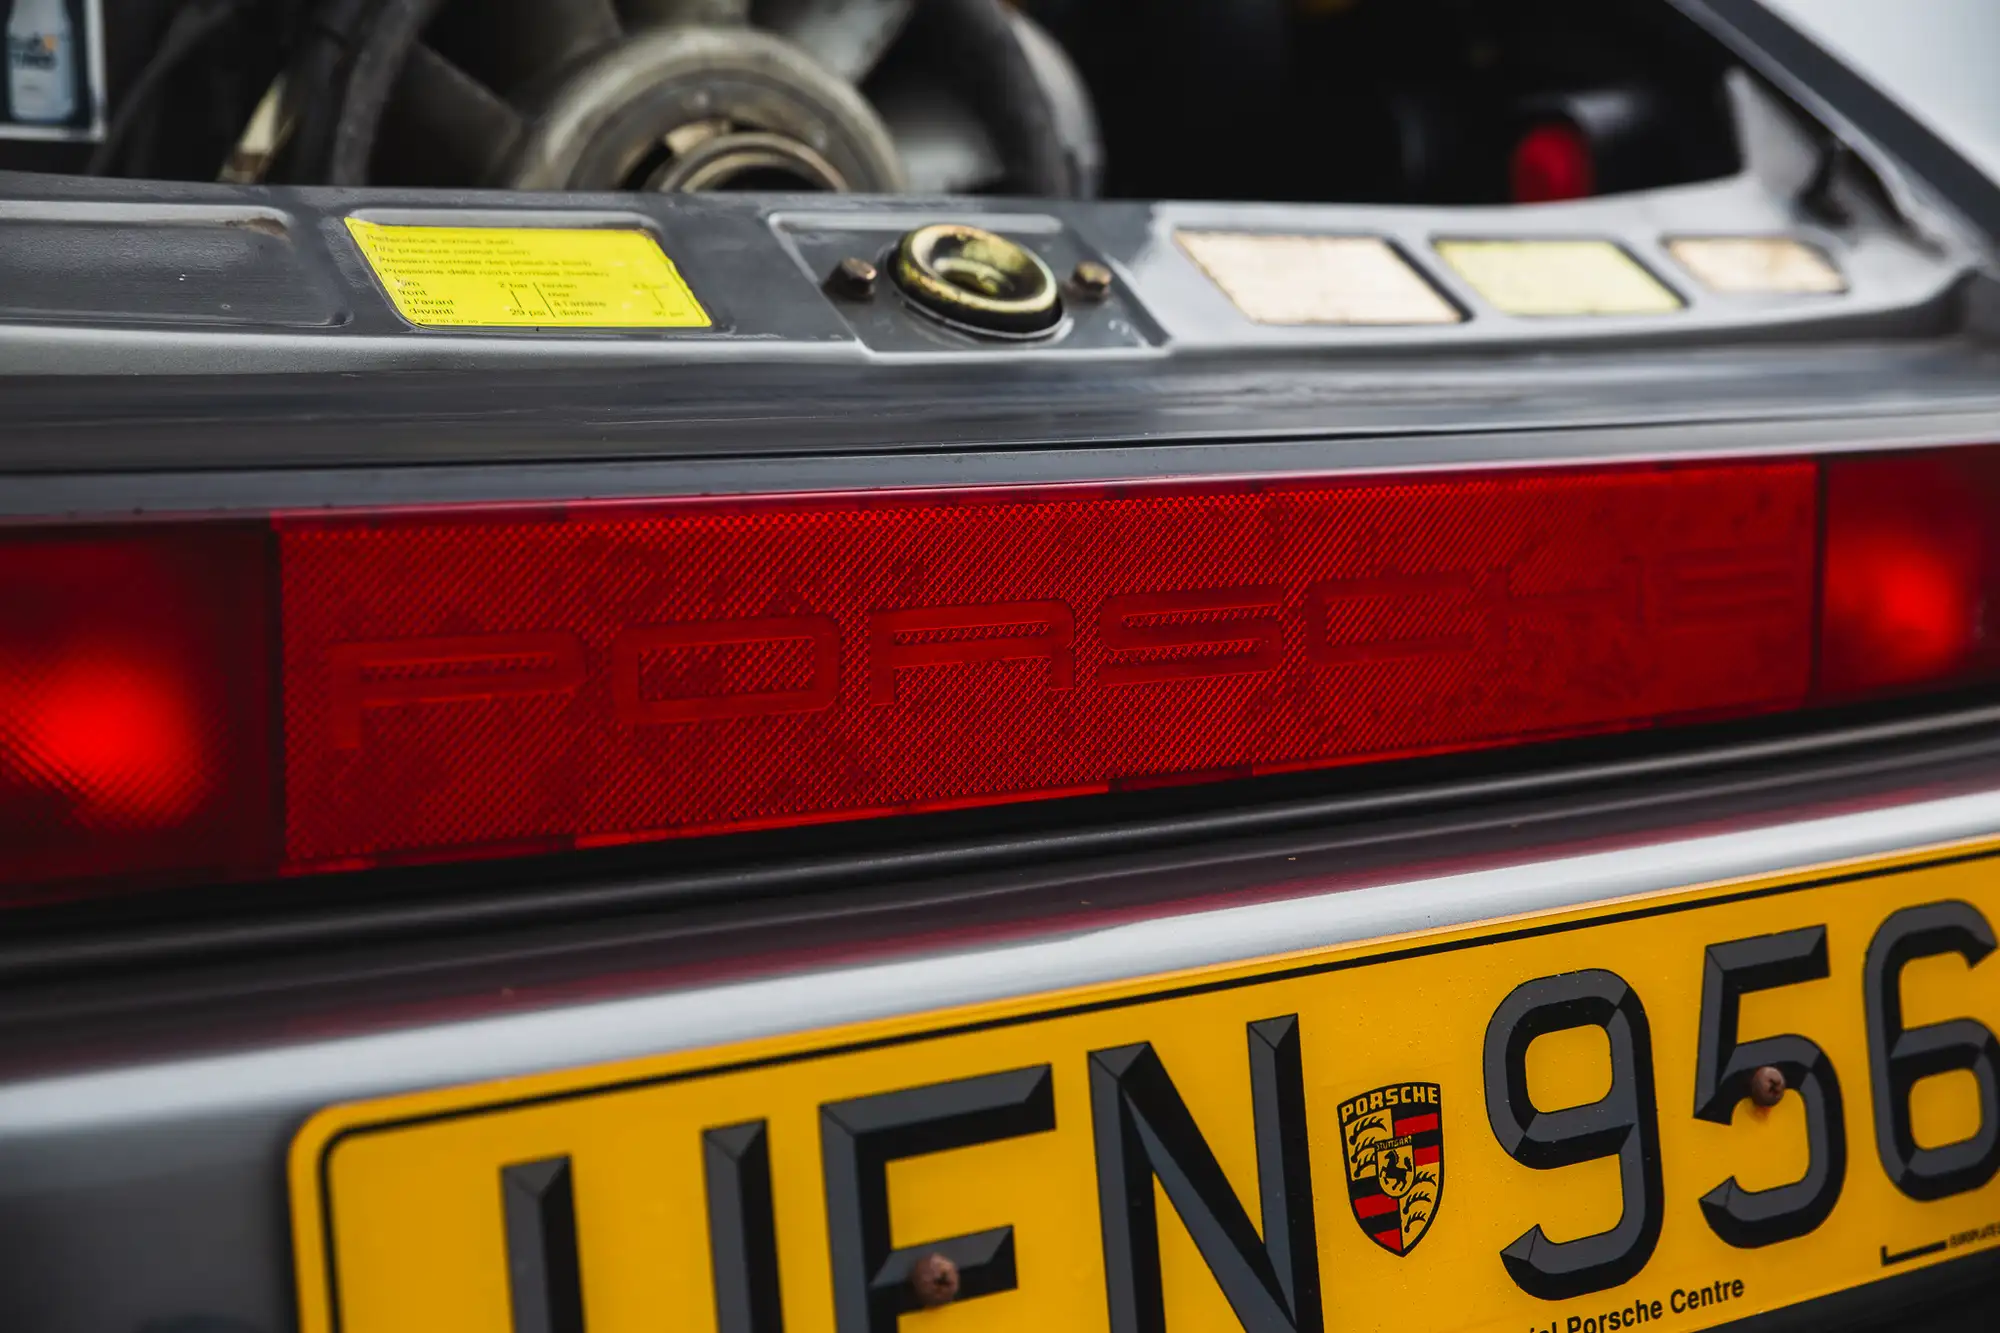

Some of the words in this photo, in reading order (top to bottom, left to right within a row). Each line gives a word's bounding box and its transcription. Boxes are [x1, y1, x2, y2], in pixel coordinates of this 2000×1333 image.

[330, 547, 1797, 751] PORSCHE
[1341, 1085, 1439, 1124] PORSCHE
[1566, 1299, 1662, 1333] Porsche
[1669, 1278, 1745, 1315] Centre
